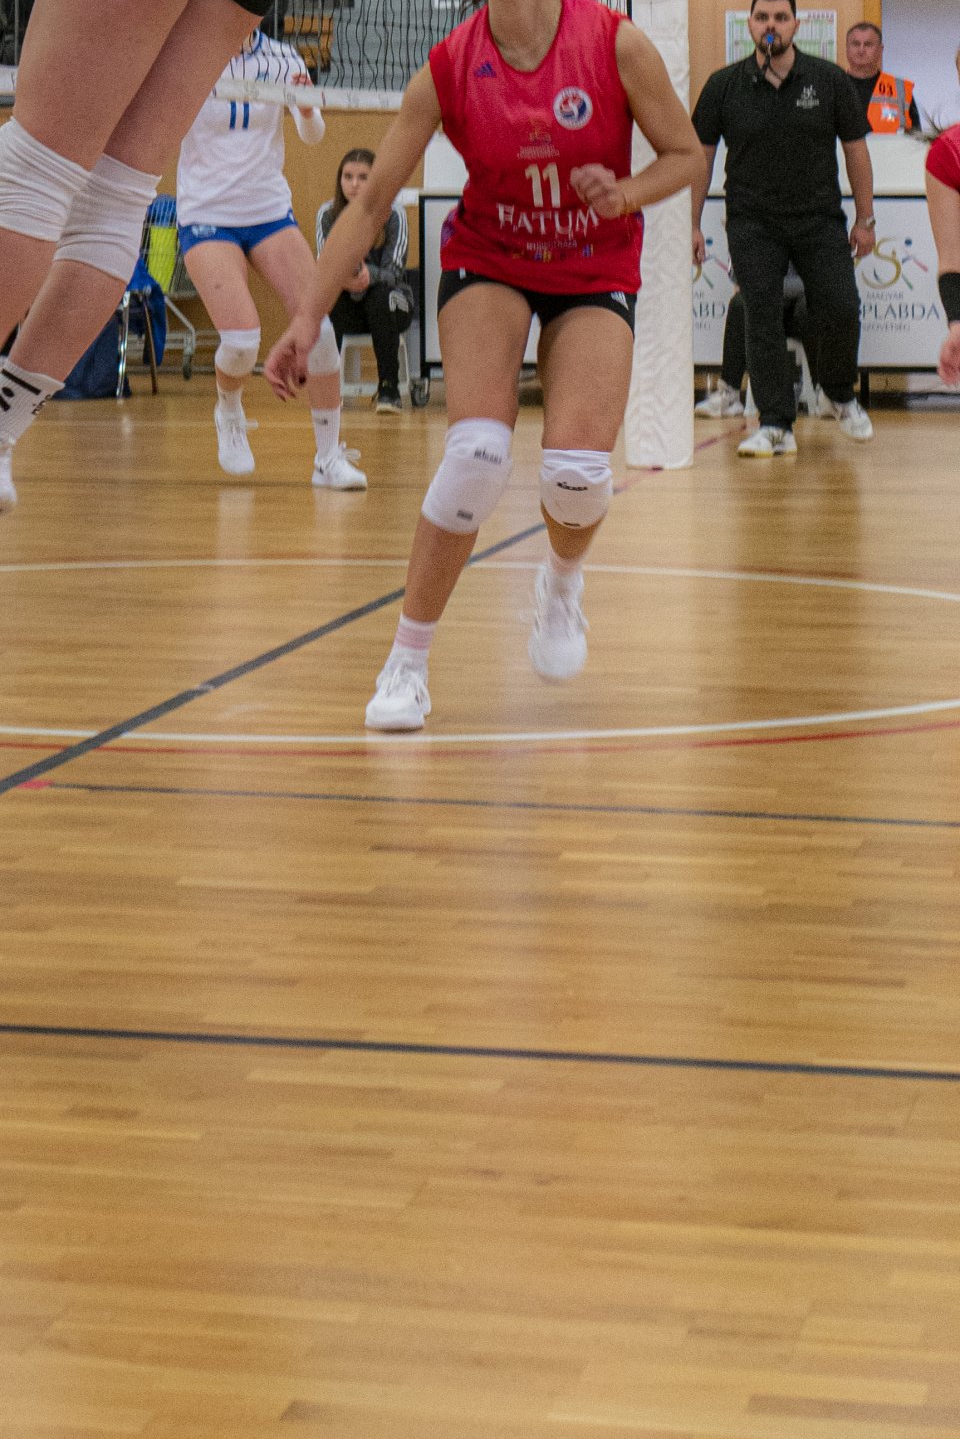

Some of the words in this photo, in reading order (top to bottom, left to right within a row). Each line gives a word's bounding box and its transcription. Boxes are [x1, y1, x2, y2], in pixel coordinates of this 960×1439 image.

[525, 163, 560, 208] 11
[496, 203, 599, 238] FATUM
[860, 303, 940, 320] PLABDA
